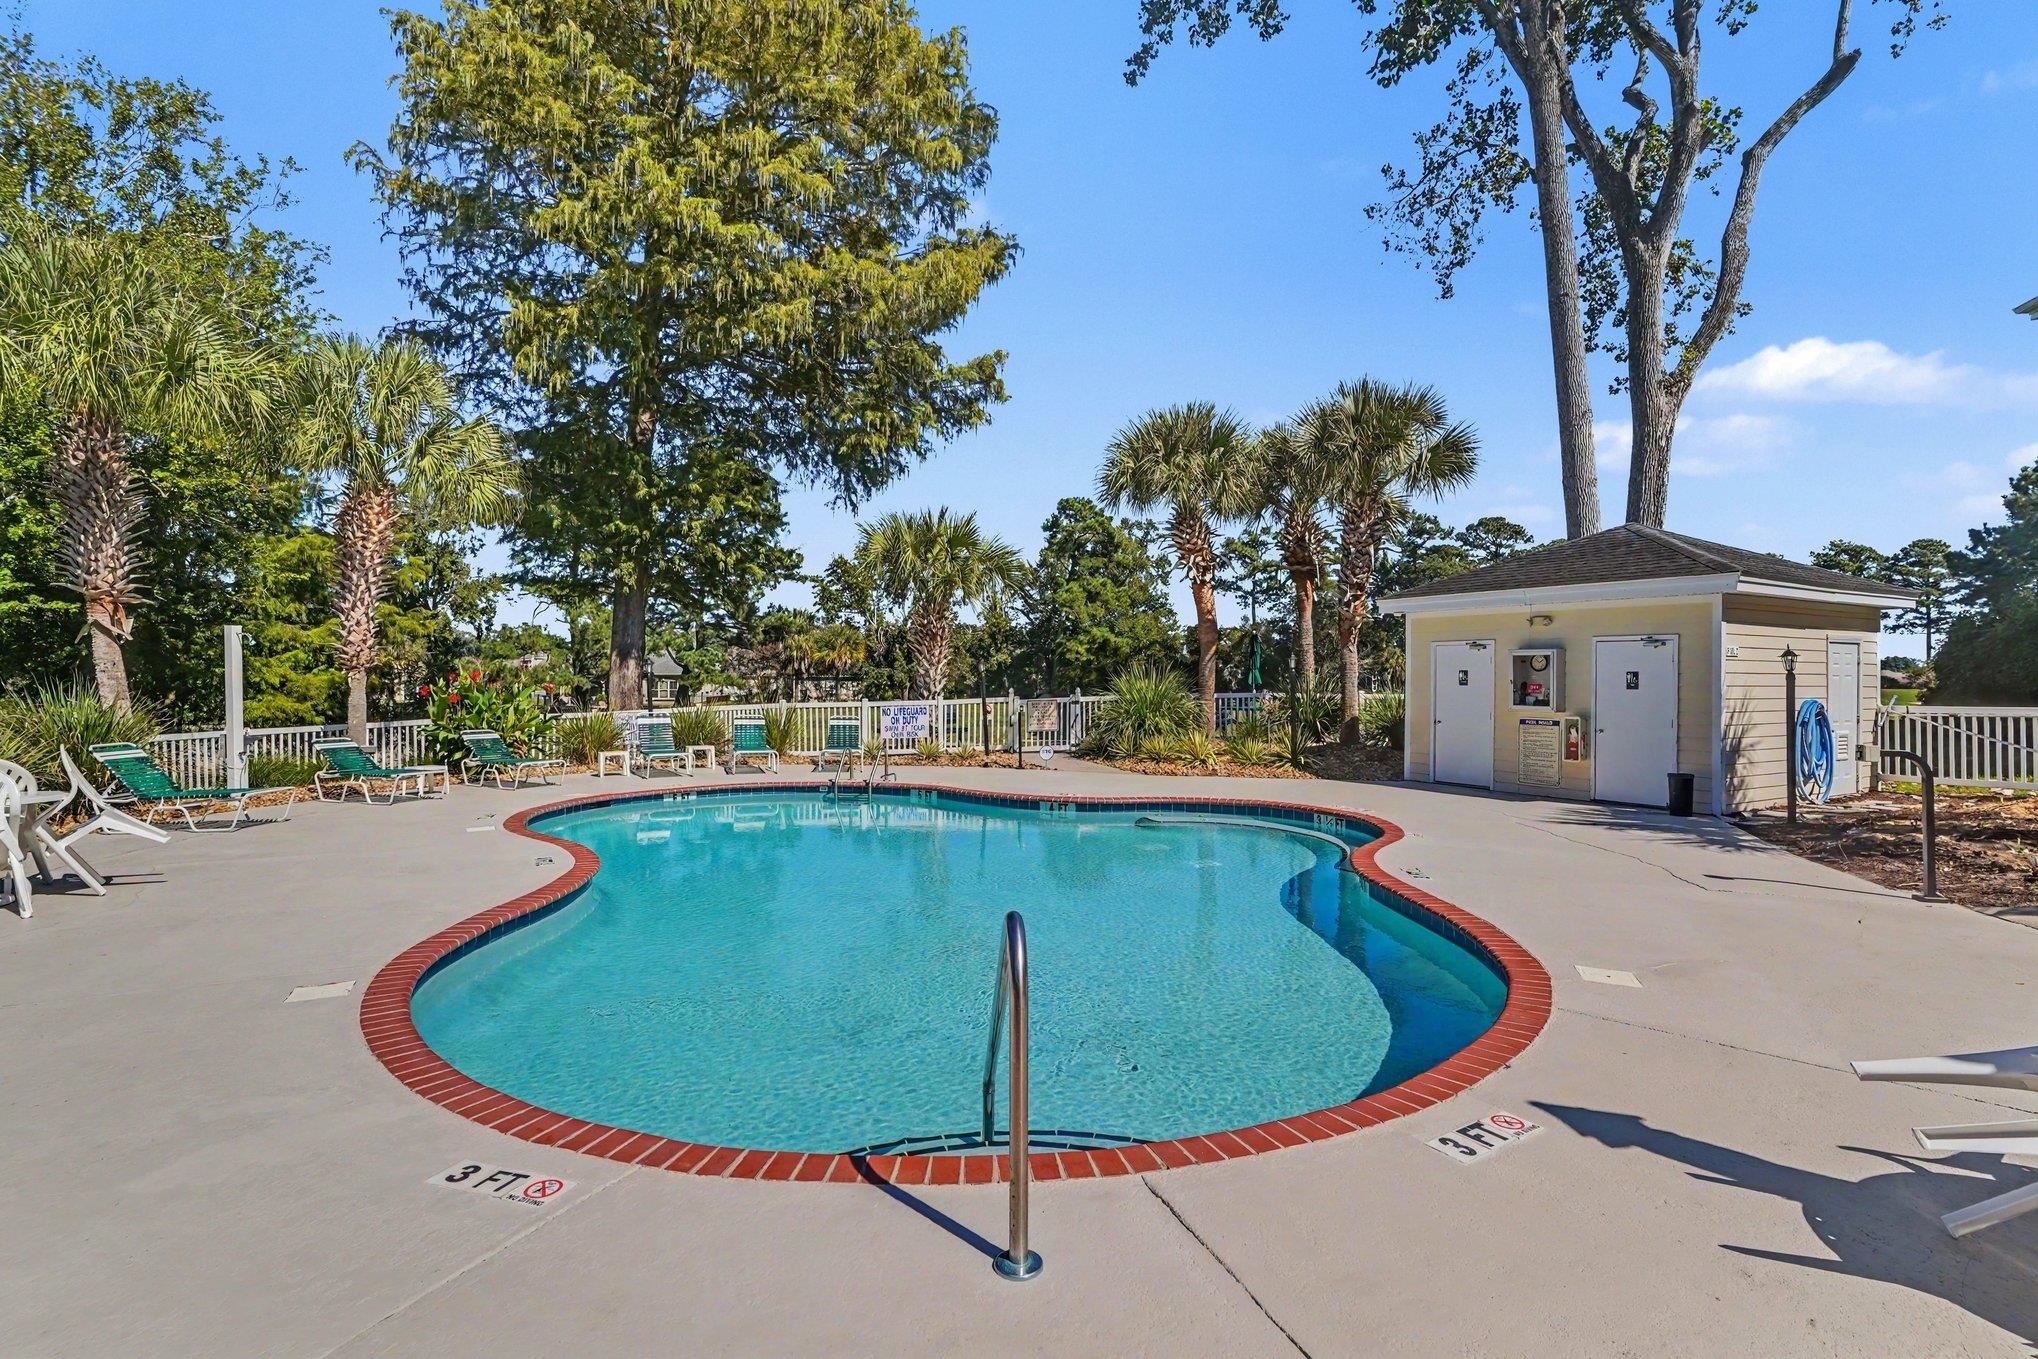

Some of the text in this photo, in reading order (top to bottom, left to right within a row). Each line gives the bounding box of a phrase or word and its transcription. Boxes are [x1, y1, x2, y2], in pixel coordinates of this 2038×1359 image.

[881, 706, 928, 716] NO LIFEGUARD
[890, 715, 919, 725] ON DUTY
[1058, 803, 1068, 812] FT
[1455, 1120, 1510, 1148] FT
[1438, 1136, 1478, 1157] 3
[444, 1164, 531, 1193] 3 FT
